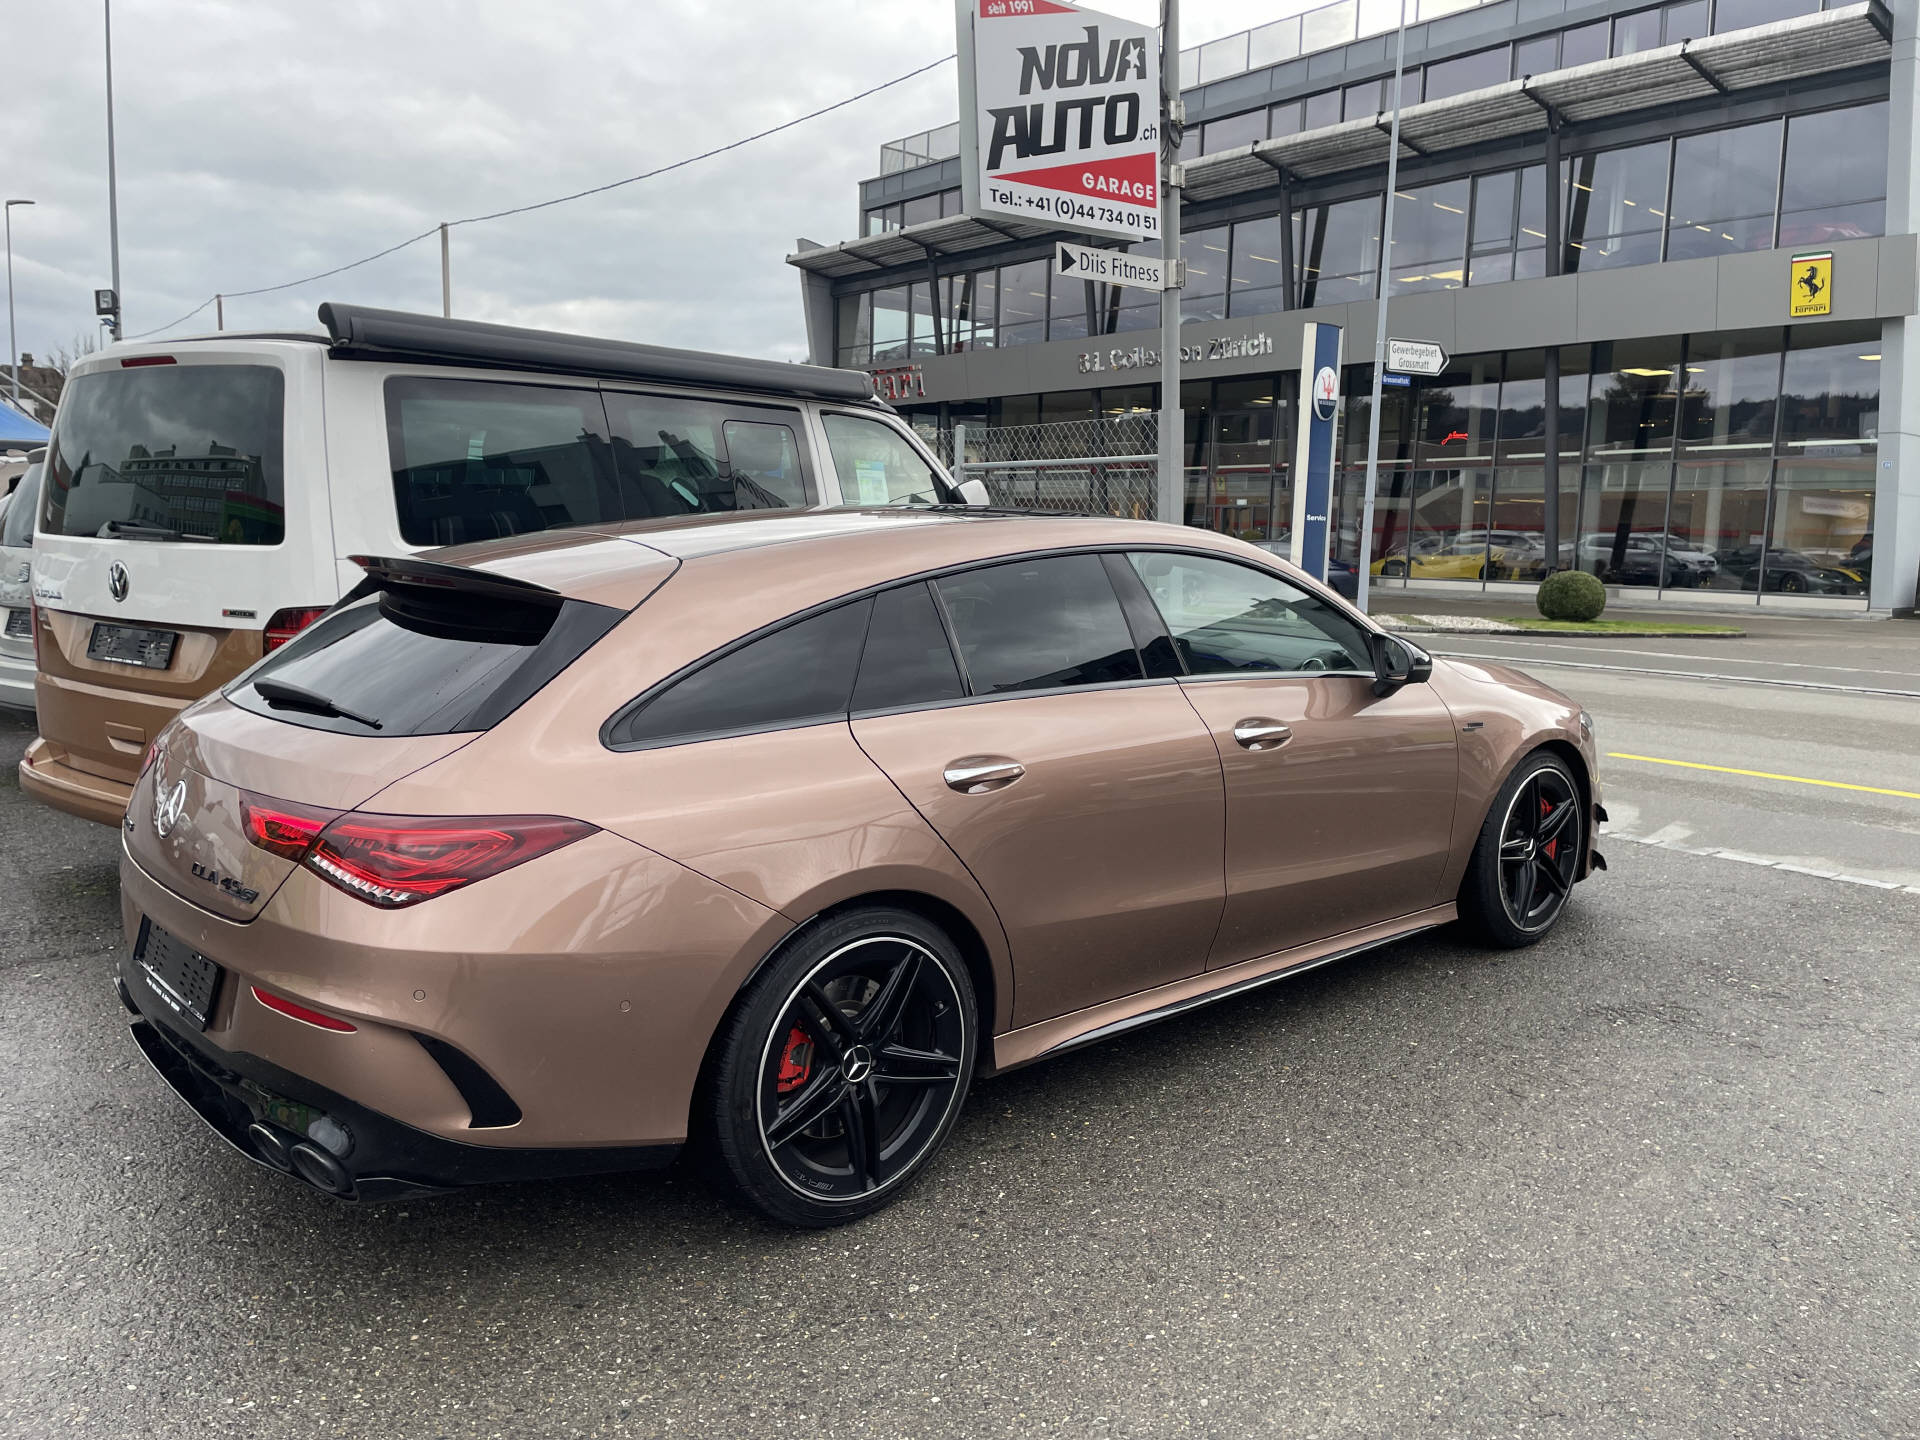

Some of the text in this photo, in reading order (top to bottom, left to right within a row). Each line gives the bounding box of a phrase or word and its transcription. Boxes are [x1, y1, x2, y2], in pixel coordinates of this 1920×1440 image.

[987, 0, 1034, 14] seit 1991
[1016, 25, 1146, 96] NOVA
[985, 92, 1140, 171] AUTO
[1082, 172, 1154, 201] GARAGE
[990, 188, 1022, 207] Tel.:
[1025, 197, 1051, 212] +41
[1055, 198, 1096, 220] (0)44
[1098, 207, 1124, 225] 734
[1080, 251, 1159, 282] Diis Fitness
[1208, 332, 1273, 360] Zürich
[1391, 343, 1437, 358] Gewerbegebiet
[1398, 357, 1429, 369] Grossmatt
